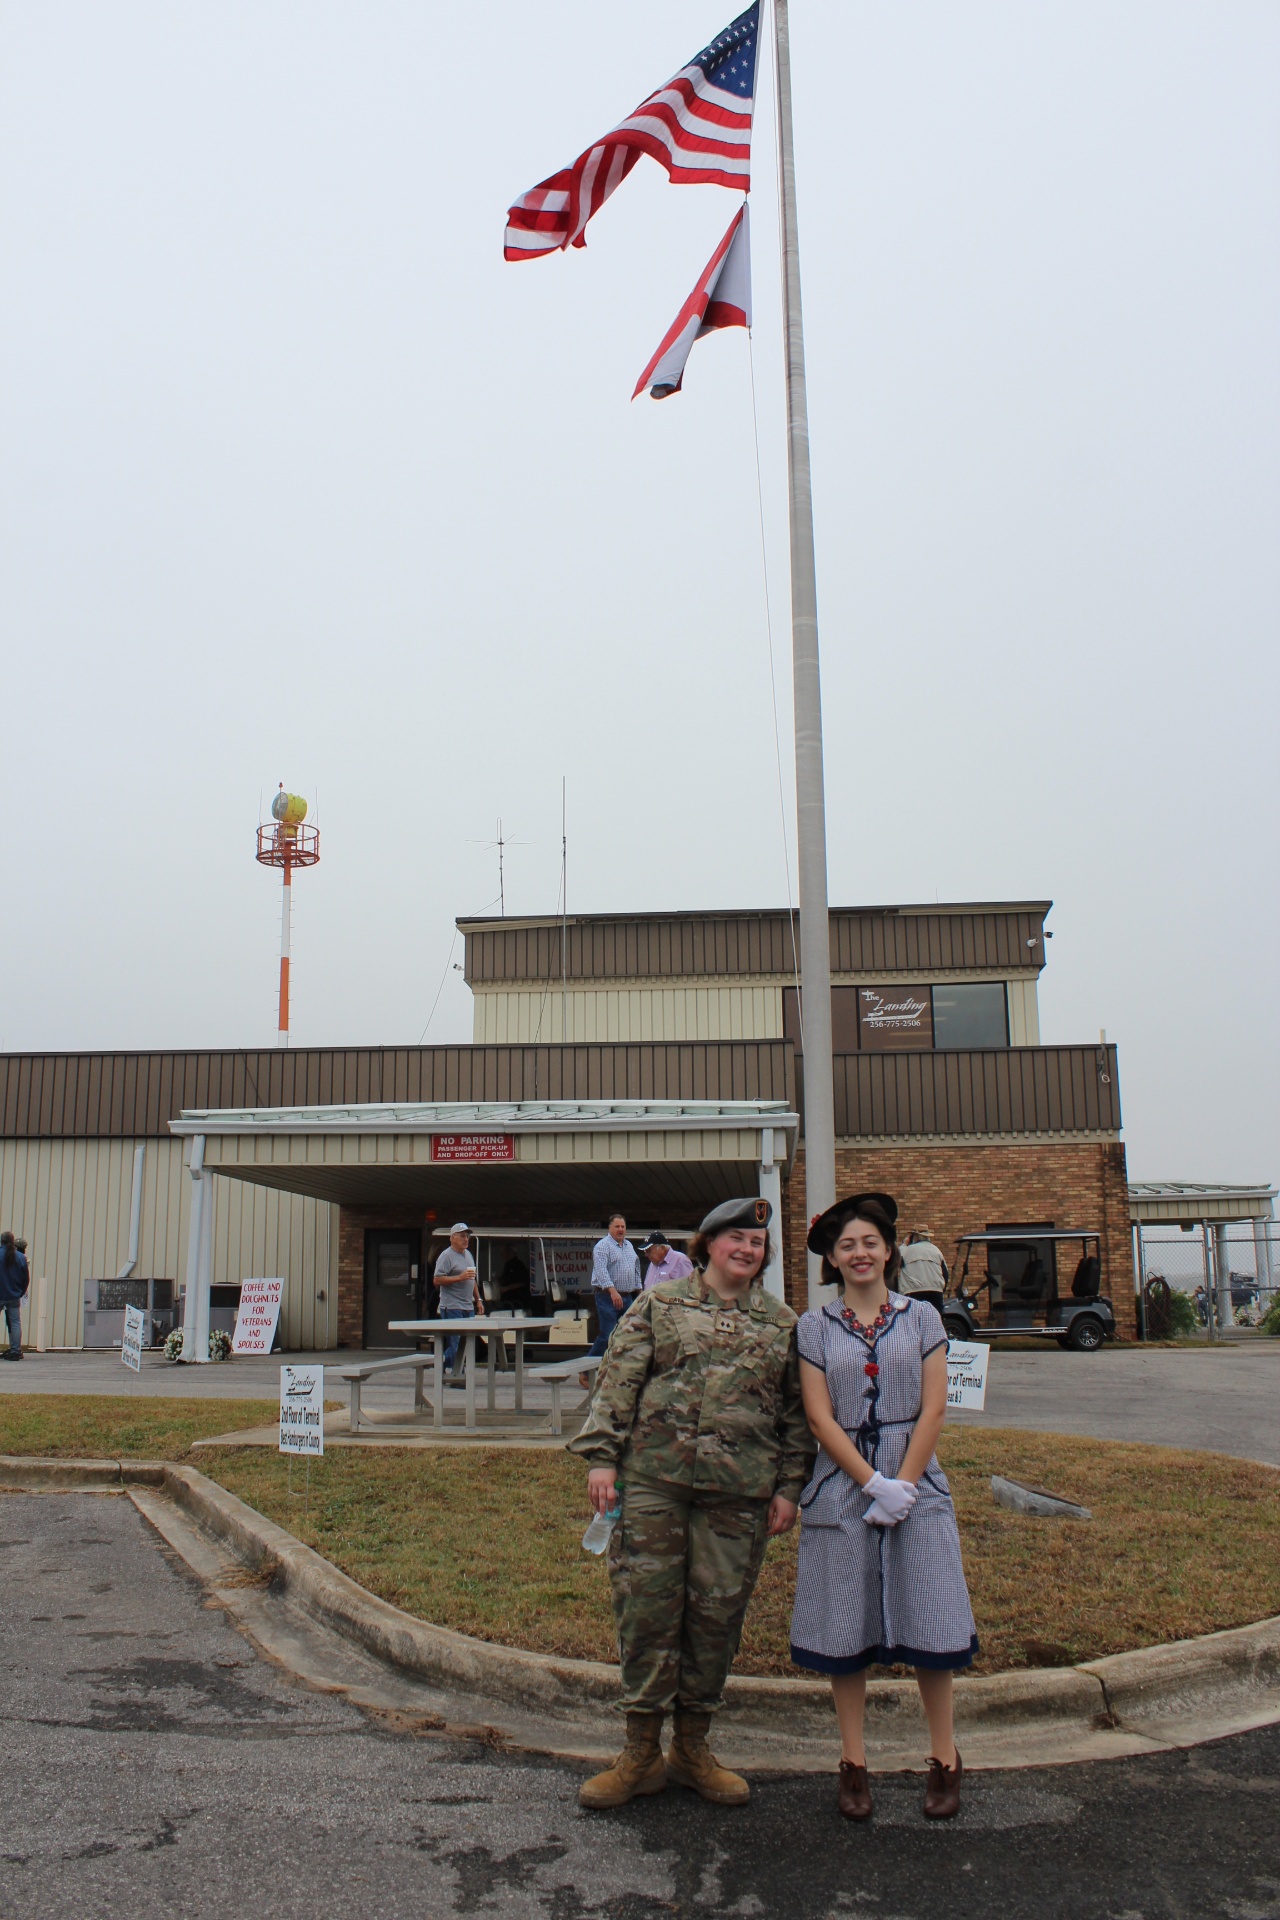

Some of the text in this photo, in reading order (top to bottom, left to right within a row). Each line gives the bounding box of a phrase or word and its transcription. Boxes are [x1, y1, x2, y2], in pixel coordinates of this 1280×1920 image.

[862, 990, 880, 1001] The
[873, 998, 928, 1012] Landing
[870, 1019, 921, 1028] 256-775-2506
[440, 1136, 505, 1145] NO PARKING
[243, 1283, 281, 1292] COFFEE AND
[241, 1294, 279, 1303] DOUGHNUTS
[252, 1306, 265, 1315] FOR
[242, 1317, 272, 1326] VETERANS
[248, 1329, 261, 1337] AND
[237, 1340, 265, 1349] SPOUSES
[949, 1350, 978, 1359] anding
[291, 1374, 316, 1388] Landing
[959, 1373, 983, 1388] Terminal
[288, 1405, 298, 1424] Floor
[298, 1406, 303, 1425] of
[303, 1406, 320, 1426] Terminal
